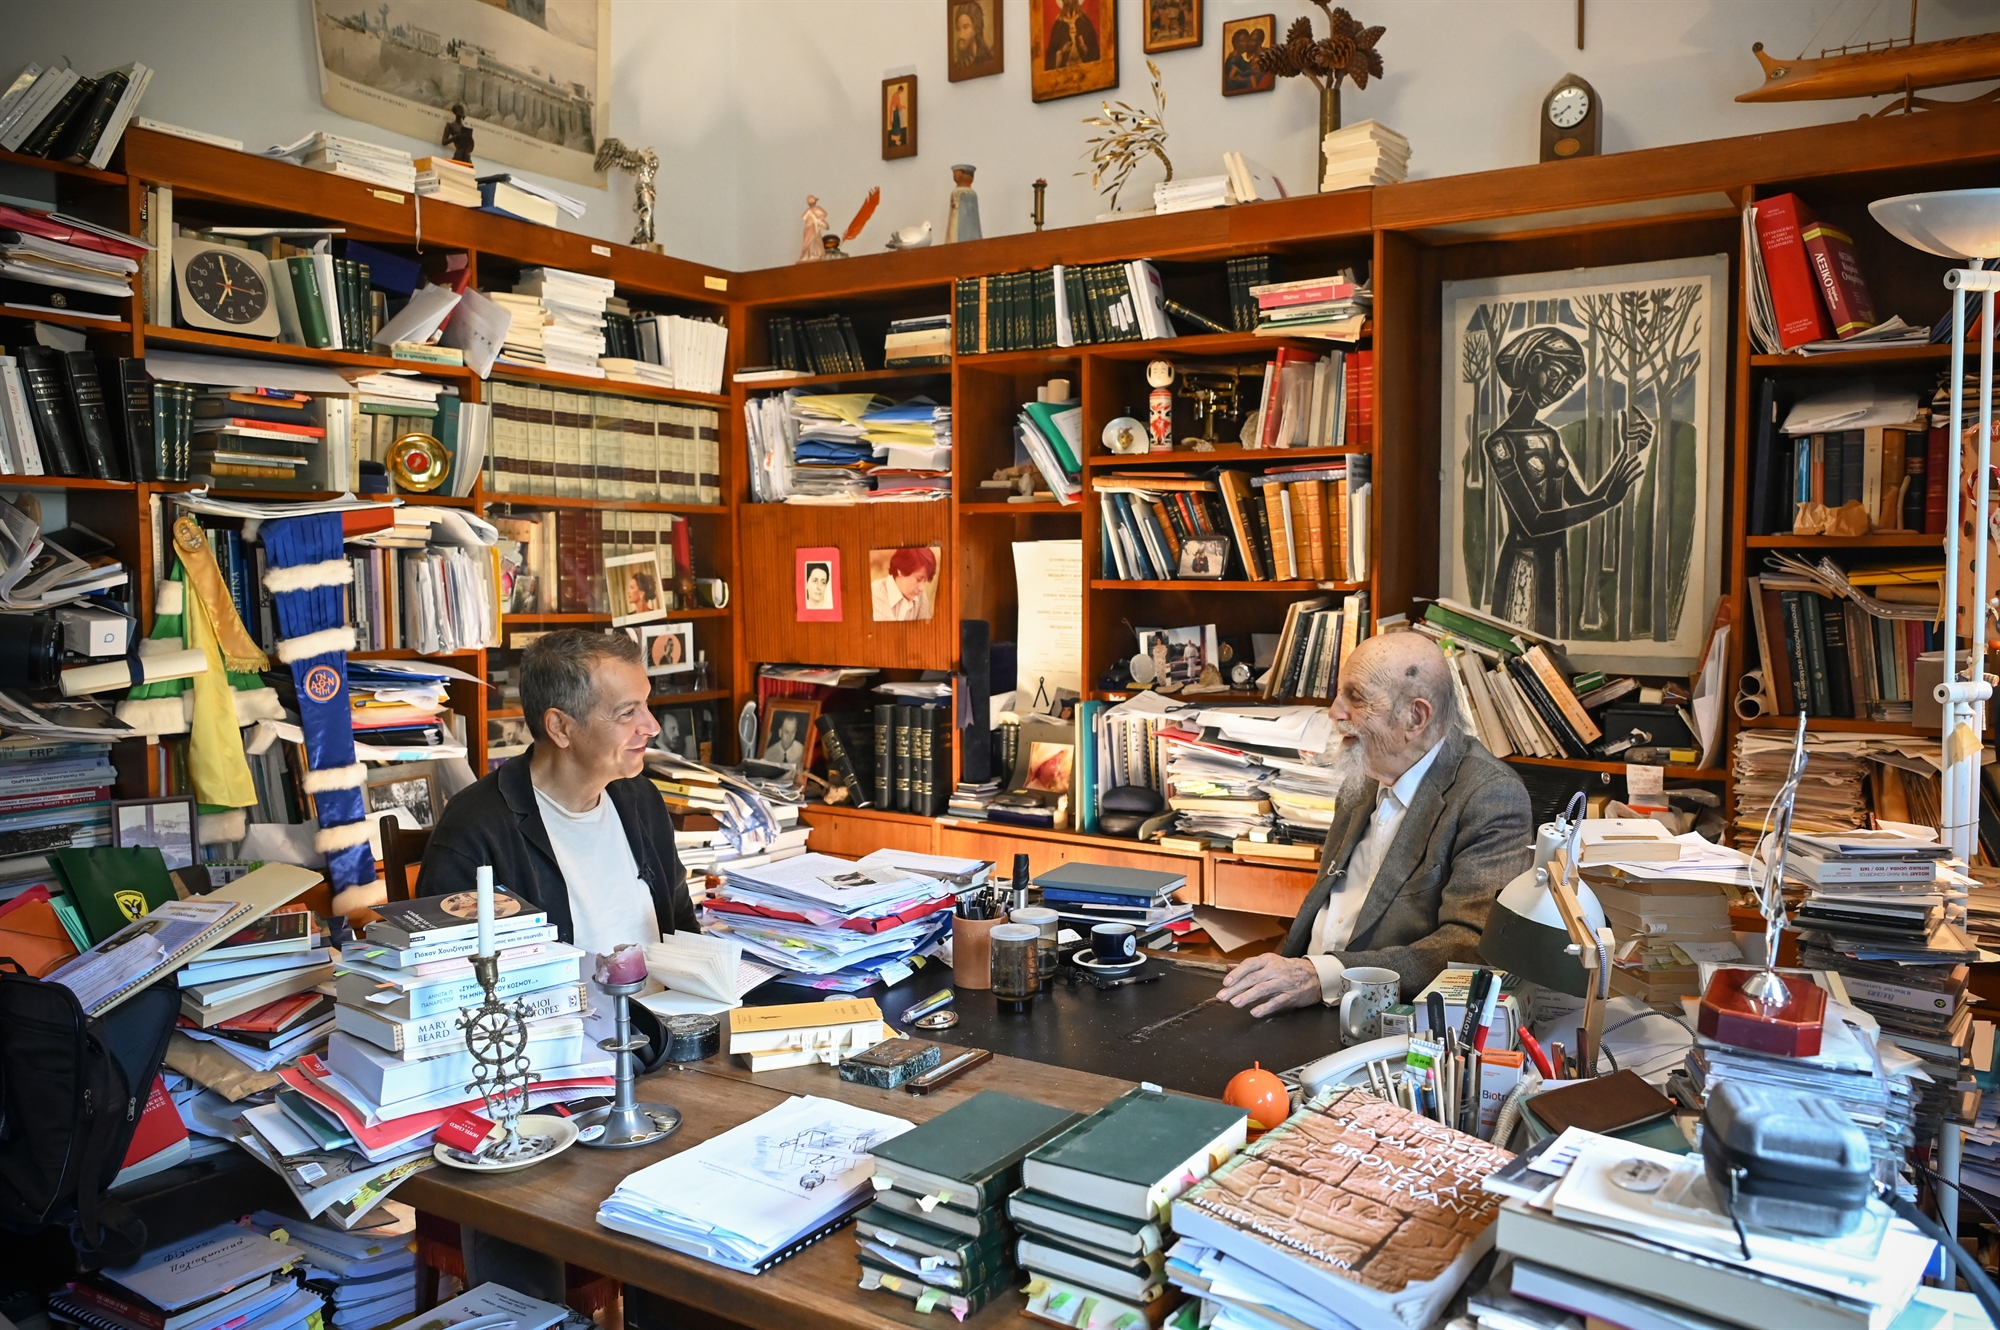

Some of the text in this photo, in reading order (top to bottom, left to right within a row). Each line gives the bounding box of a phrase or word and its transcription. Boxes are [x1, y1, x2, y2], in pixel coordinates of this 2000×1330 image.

[1814, 253, 1834, 288] ΛΕΞΙΚΟ
[260, 581, 270, 608] Picas
[1790, 602, 1799, 628] Abnormal
[1793, 629, 1802, 658] Psychology
[29, 748, 54, 757] FRP
[428, 991, 447, 1000] ΑΝΝΙΤΑ
[494, 985, 507, 993] ΤΟΥ
[421, 997, 454, 1009] ΠΑΝΑΡΕΤΟΥ
[418, 1020, 448, 1033] MARY
[1463, 1012, 1473, 1034] PILOT
[418, 1029, 450, 1043] BEARD
[1482, 1090, 1508, 1101] Biotr
[1335, 1118, 1486, 1181] SEAMANSH
[1410, 1121, 1509, 1166] SEAGOIN
[1331, 1143, 1496, 1211] BRONZE AGE
[1413, 1160, 1446, 1177] IN
[1379, 1175, 1488, 1220] LEVANT
[1194, 1196, 1352, 1270] SHELLEY WACHSMANN
